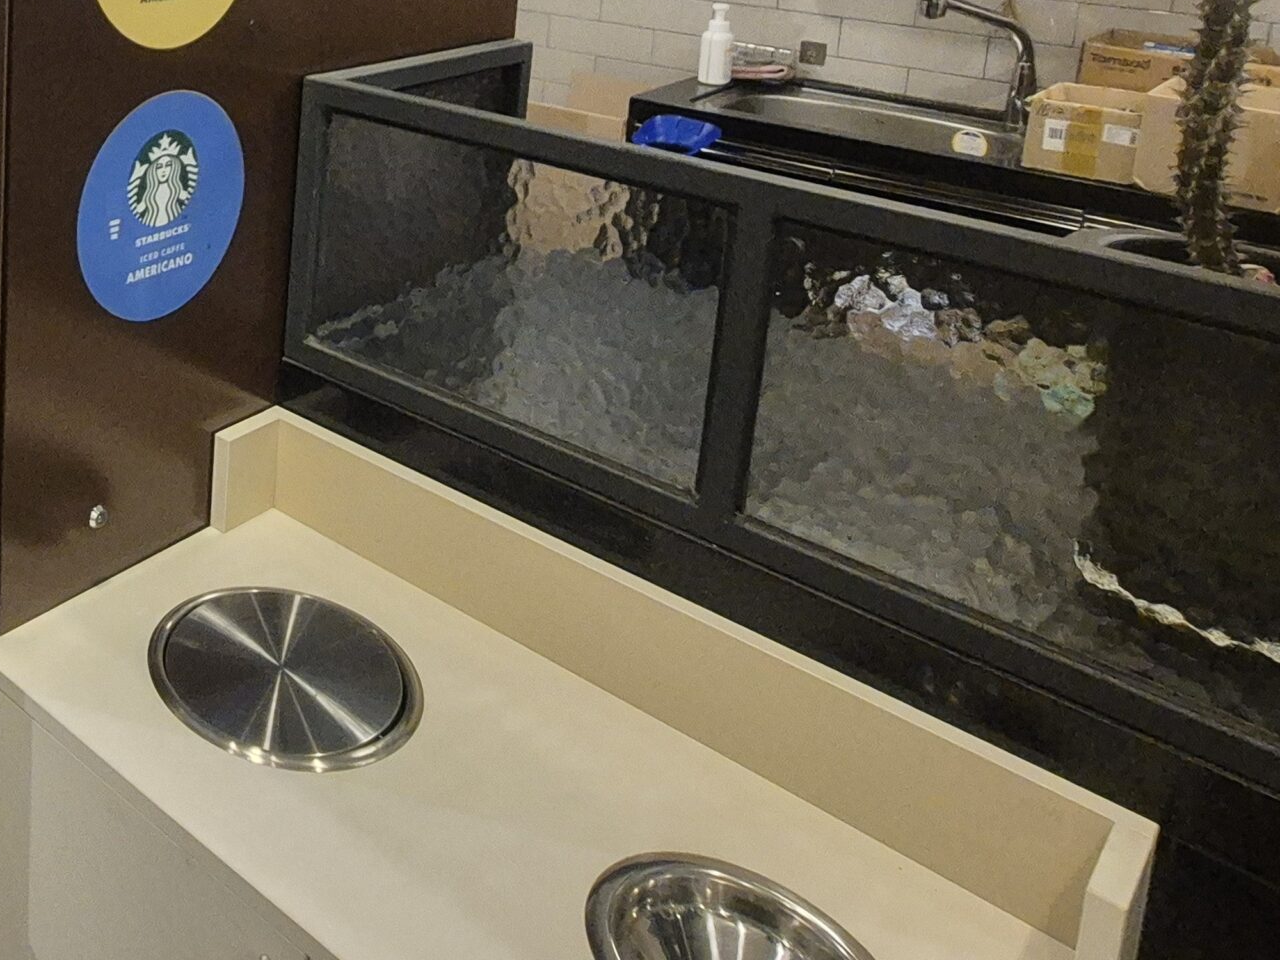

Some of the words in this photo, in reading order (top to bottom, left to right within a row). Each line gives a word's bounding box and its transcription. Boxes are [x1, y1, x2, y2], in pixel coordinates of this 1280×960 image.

[135, 223, 191, 248] STARBUCKS
[126, 252, 193, 285] AMERICANO
[140, 251, 159, 263] ICED
